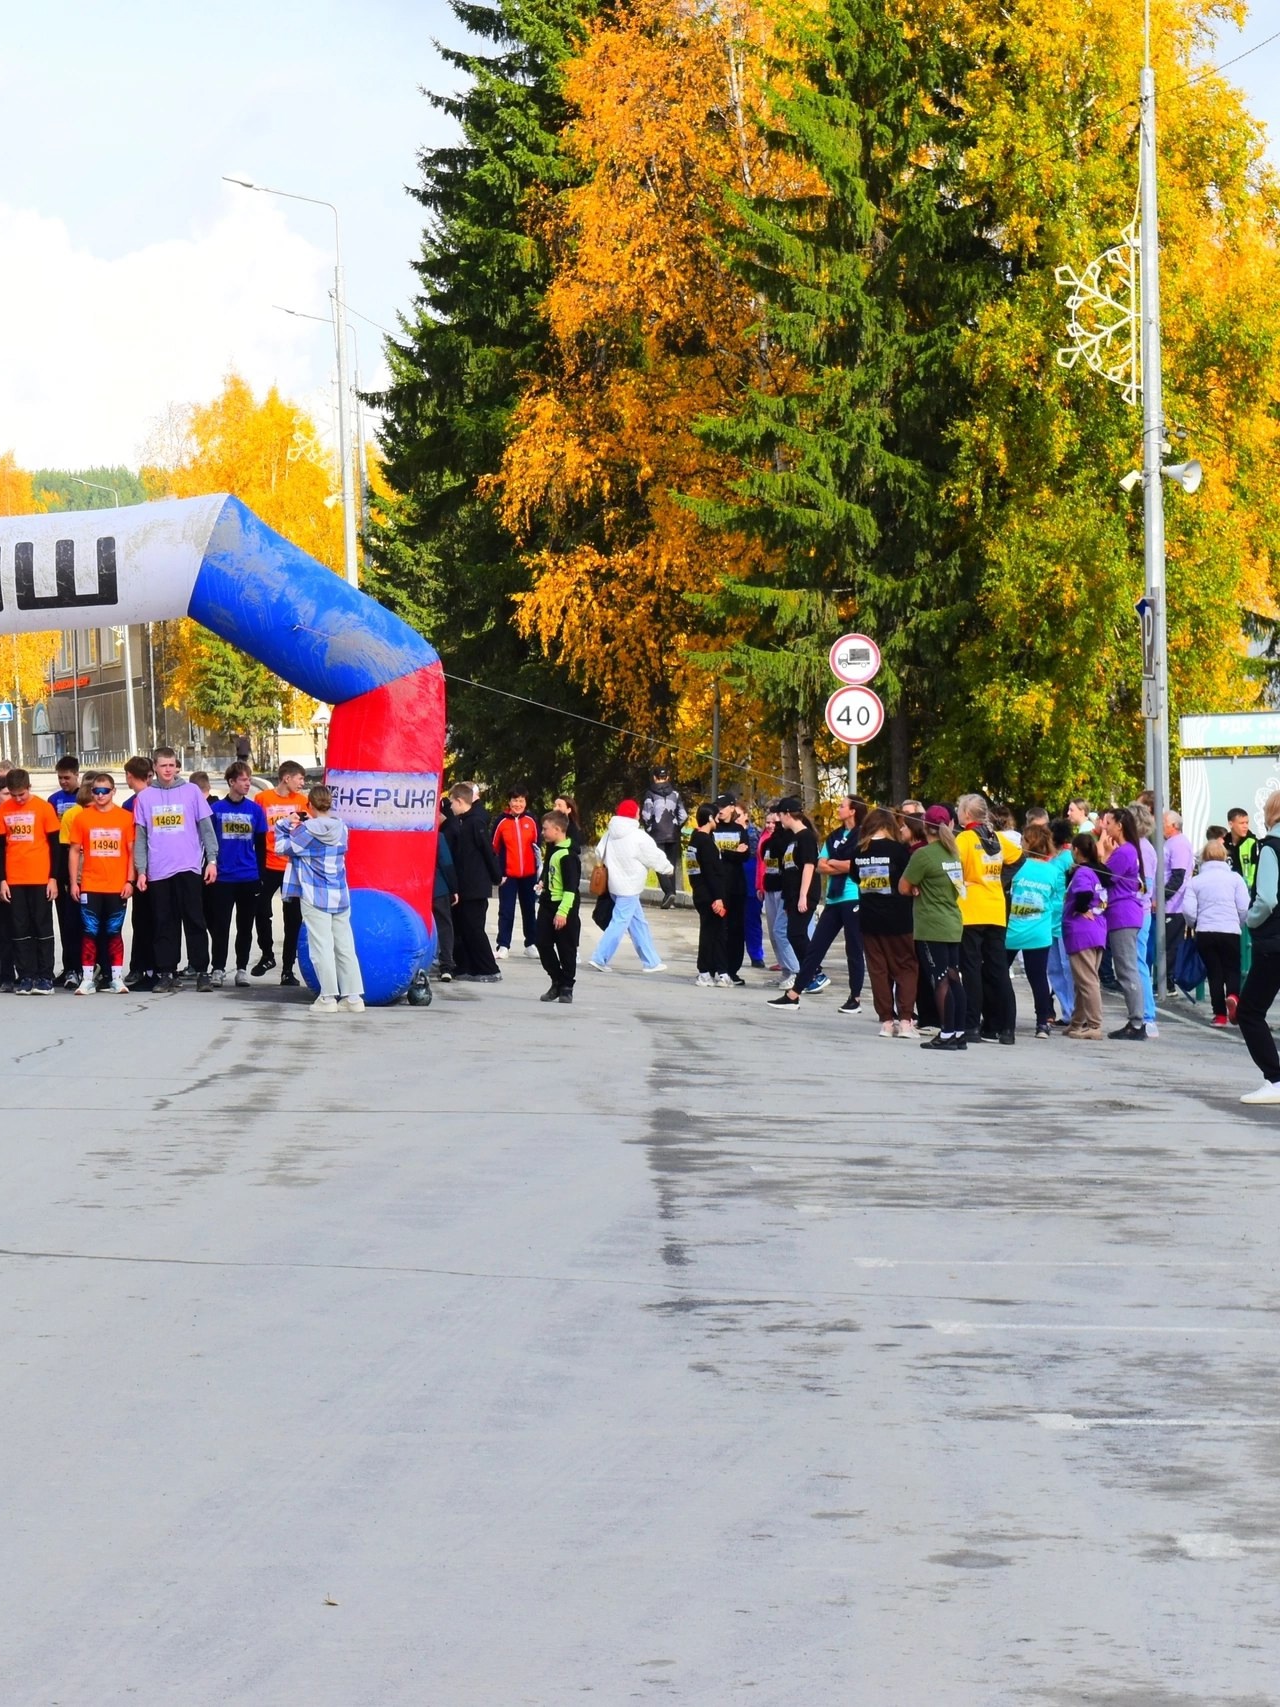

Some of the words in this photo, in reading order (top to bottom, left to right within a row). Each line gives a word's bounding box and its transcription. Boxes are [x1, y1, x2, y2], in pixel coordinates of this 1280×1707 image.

[836, 705, 870, 726] 40
[155, 815, 182, 825] 14692
[224, 823, 250, 833] 14950
[93, 840, 119, 850] 14940
